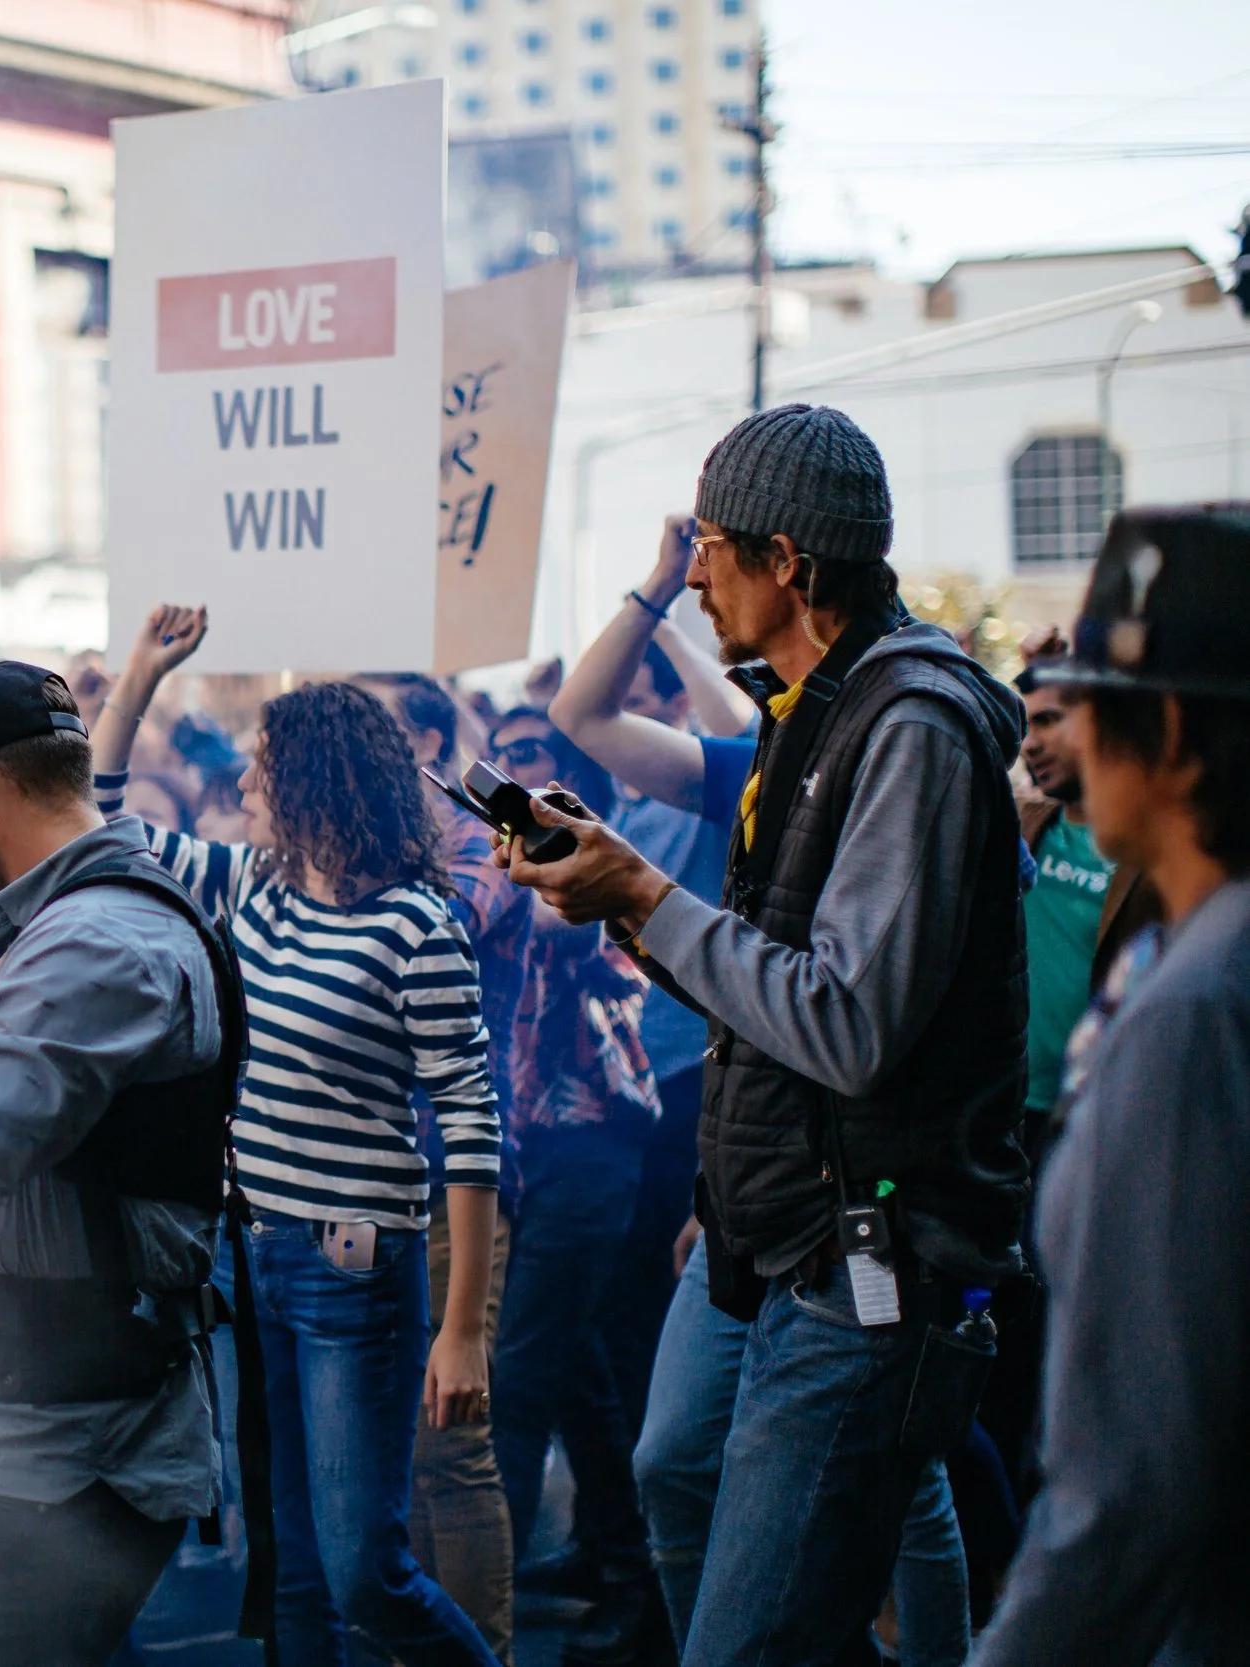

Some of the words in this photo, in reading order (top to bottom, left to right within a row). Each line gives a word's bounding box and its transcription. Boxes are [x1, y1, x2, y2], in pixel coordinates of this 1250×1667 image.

[218, 284, 337, 350] LOVE
[213, 384, 339, 450] WILL
[225, 488, 325, 552] WIN
